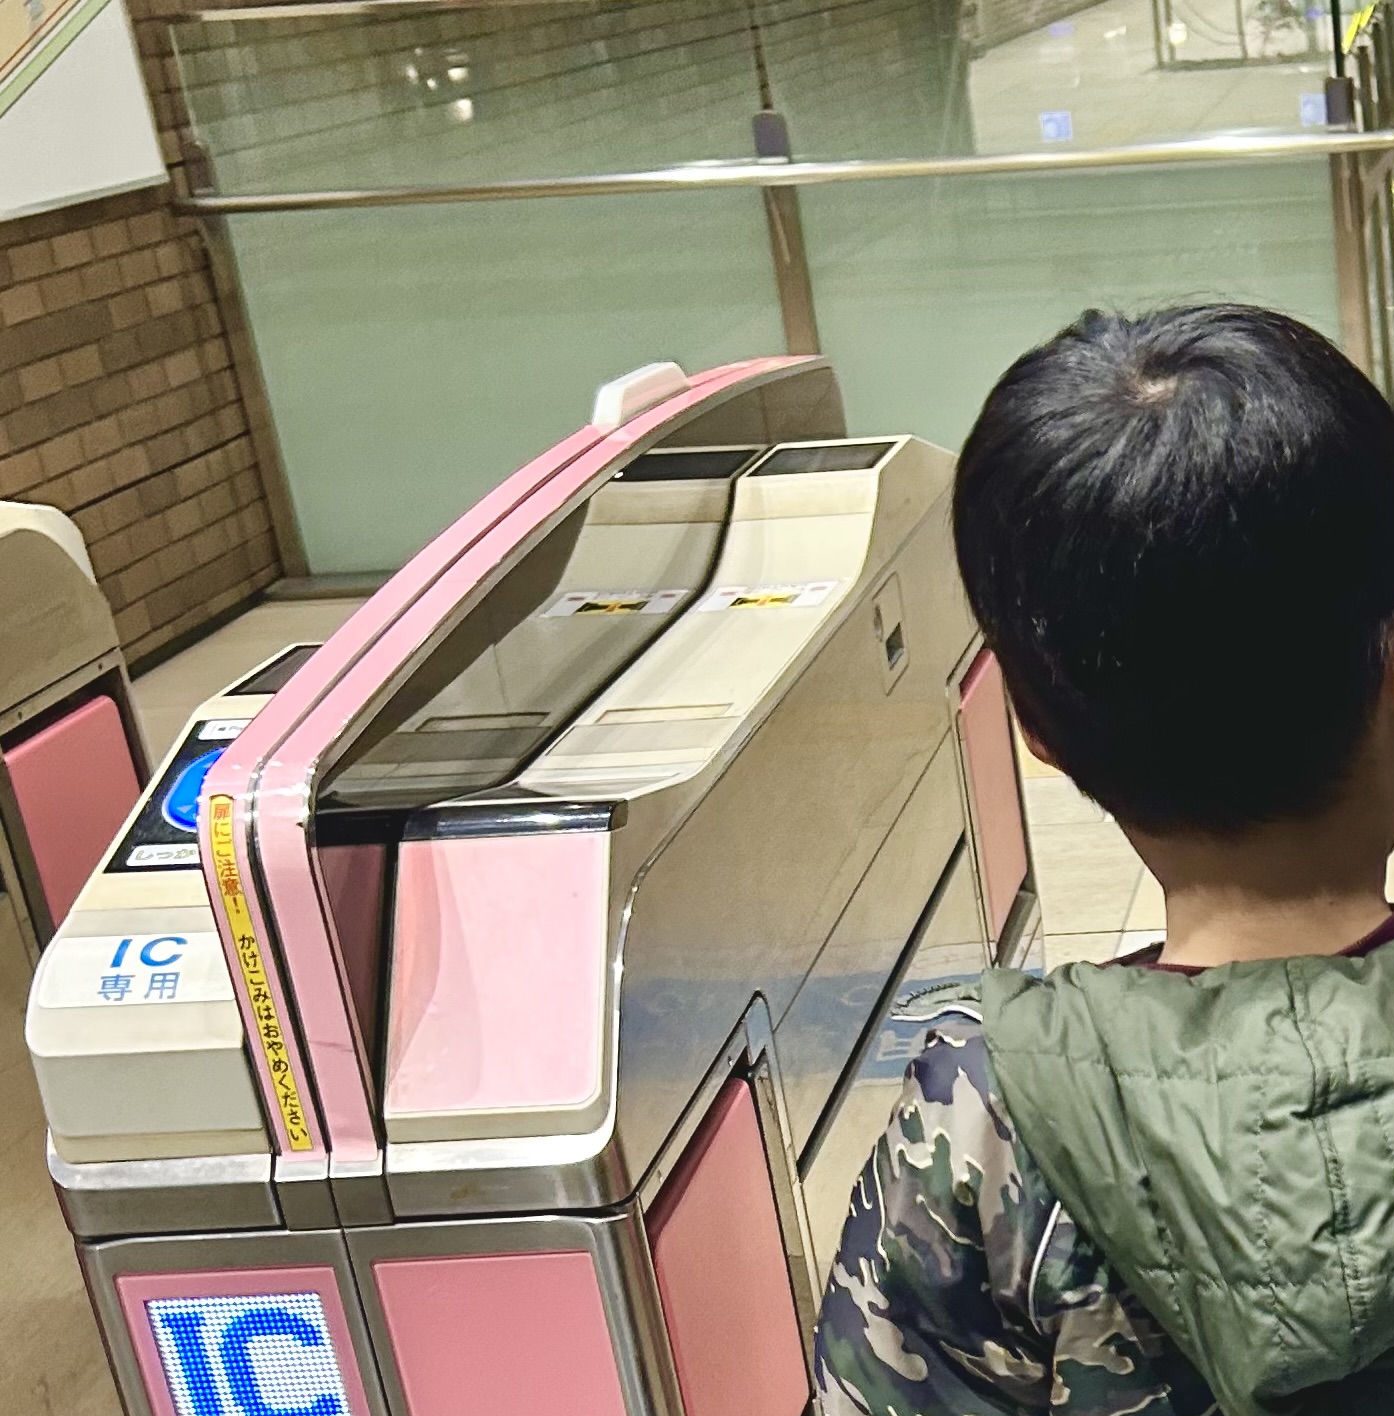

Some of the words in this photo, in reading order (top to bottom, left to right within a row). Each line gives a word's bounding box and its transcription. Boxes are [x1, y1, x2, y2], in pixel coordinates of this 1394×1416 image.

[110, 936, 189, 969] IC
[97, 971, 181, 1002] 専用
[238, 934, 308, 1142] かけこみはおやめください
